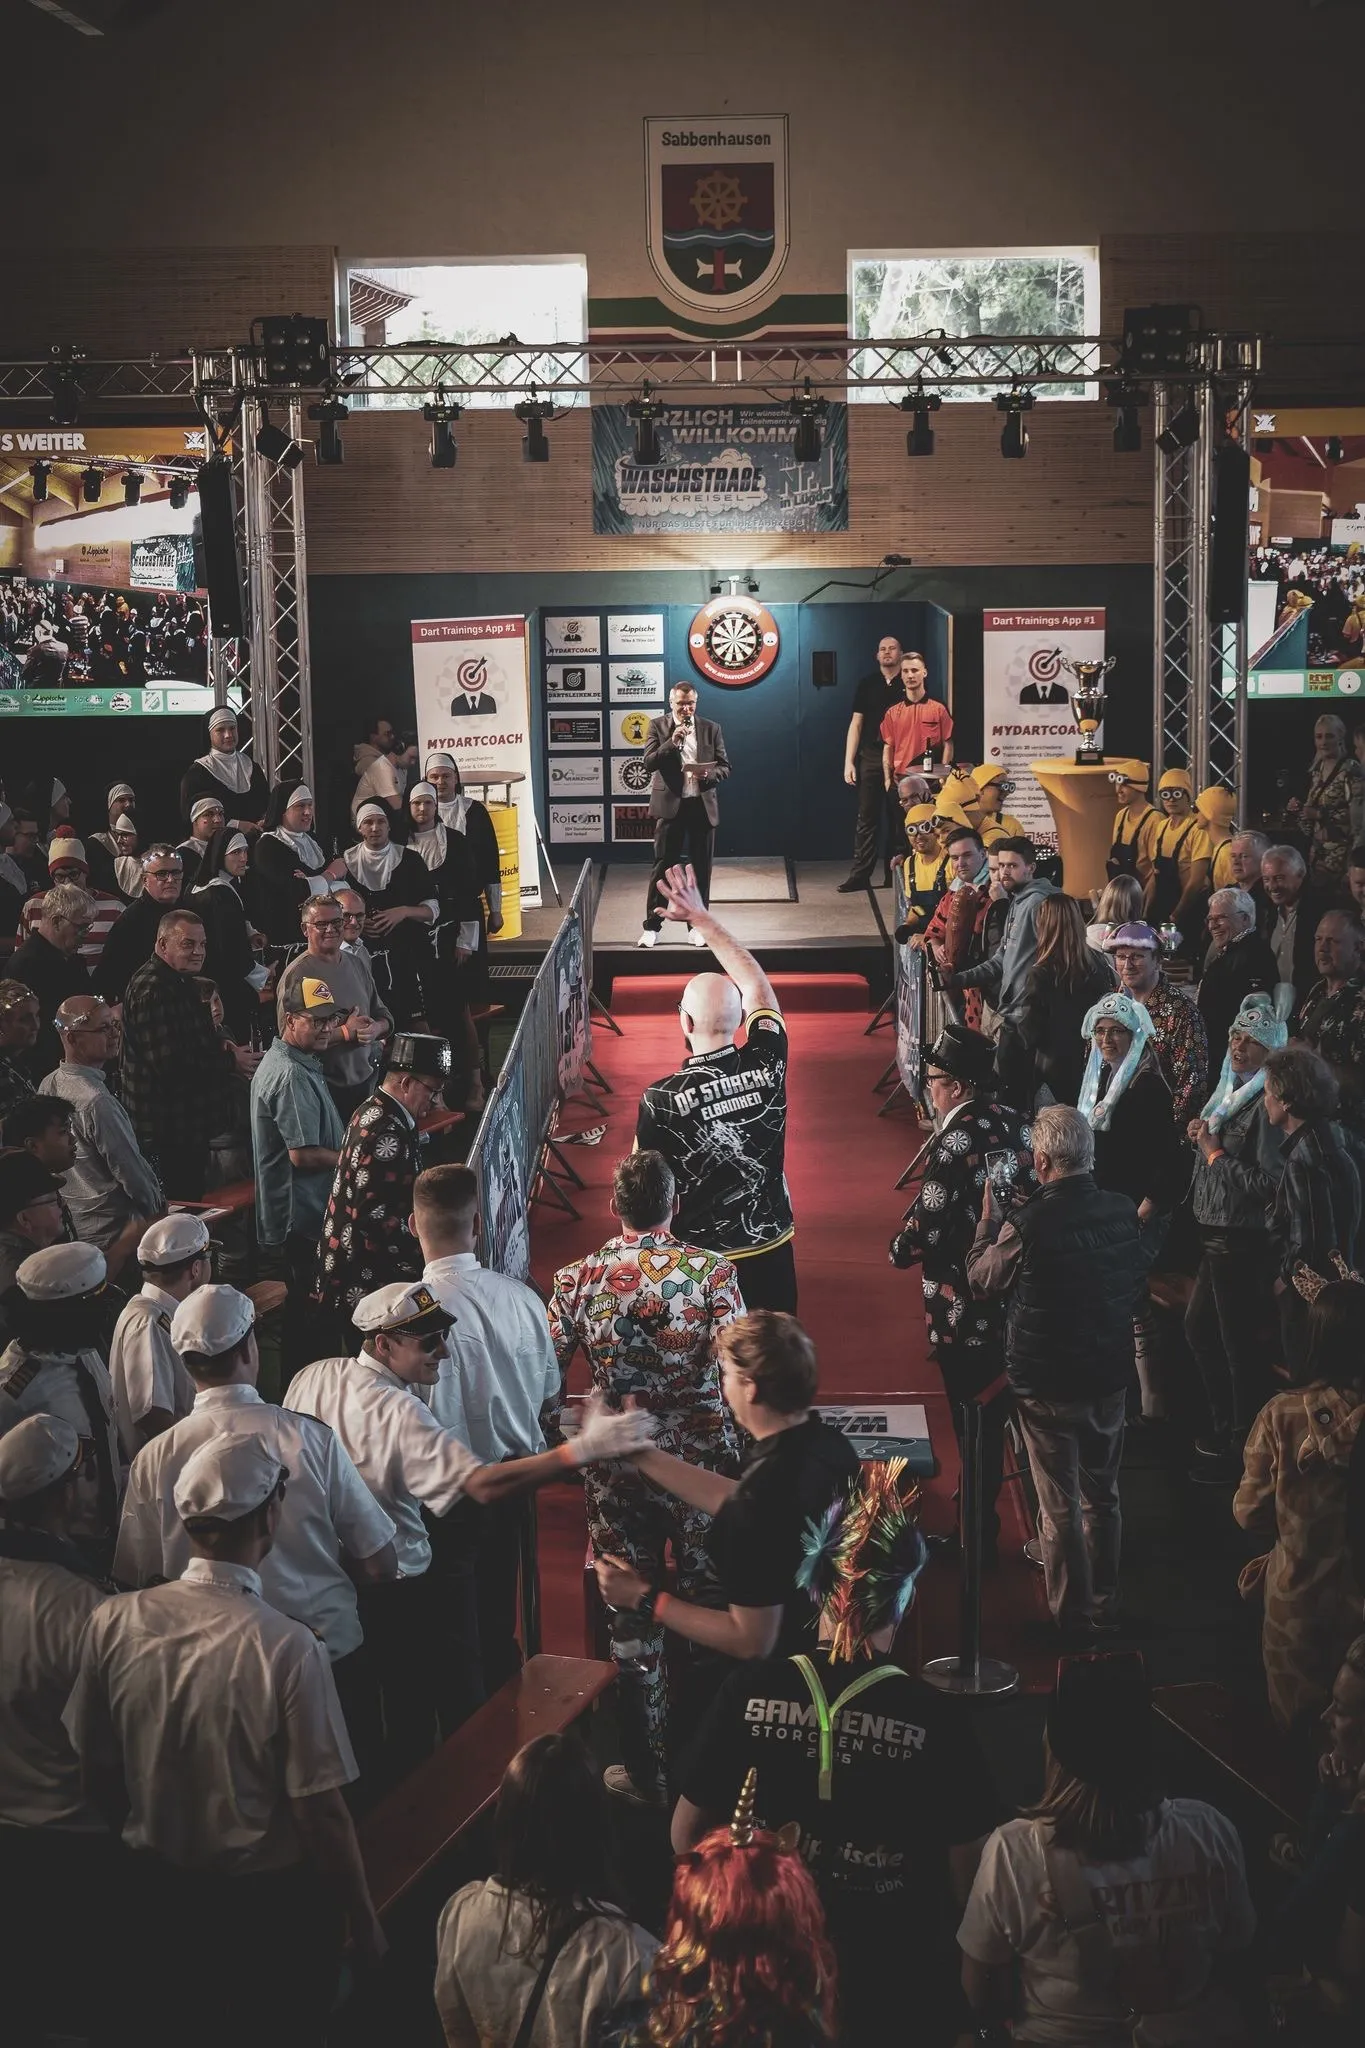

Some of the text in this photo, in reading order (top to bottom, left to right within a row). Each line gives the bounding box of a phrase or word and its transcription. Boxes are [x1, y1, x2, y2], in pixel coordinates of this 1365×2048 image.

[661, 131, 771, 146] Sabbenhausen
[16, 433, 87, 451] WEITER
[671, 493, 744, 502] KREISEL
[992, 616, 1096, 626] Dart Trainings App #1
[421, 623, 516, 637] Dart Trainings App #1
[427, 733, 523, 749] MYDARTCOACH
[552, 811, 601, 824] Roicom
[674, 1067, 776, 1117] DC STÖRCHE
[588, 1297, 616, 1316] BANG!
[751, 1724, 912, 1763] STORCEN CUP
